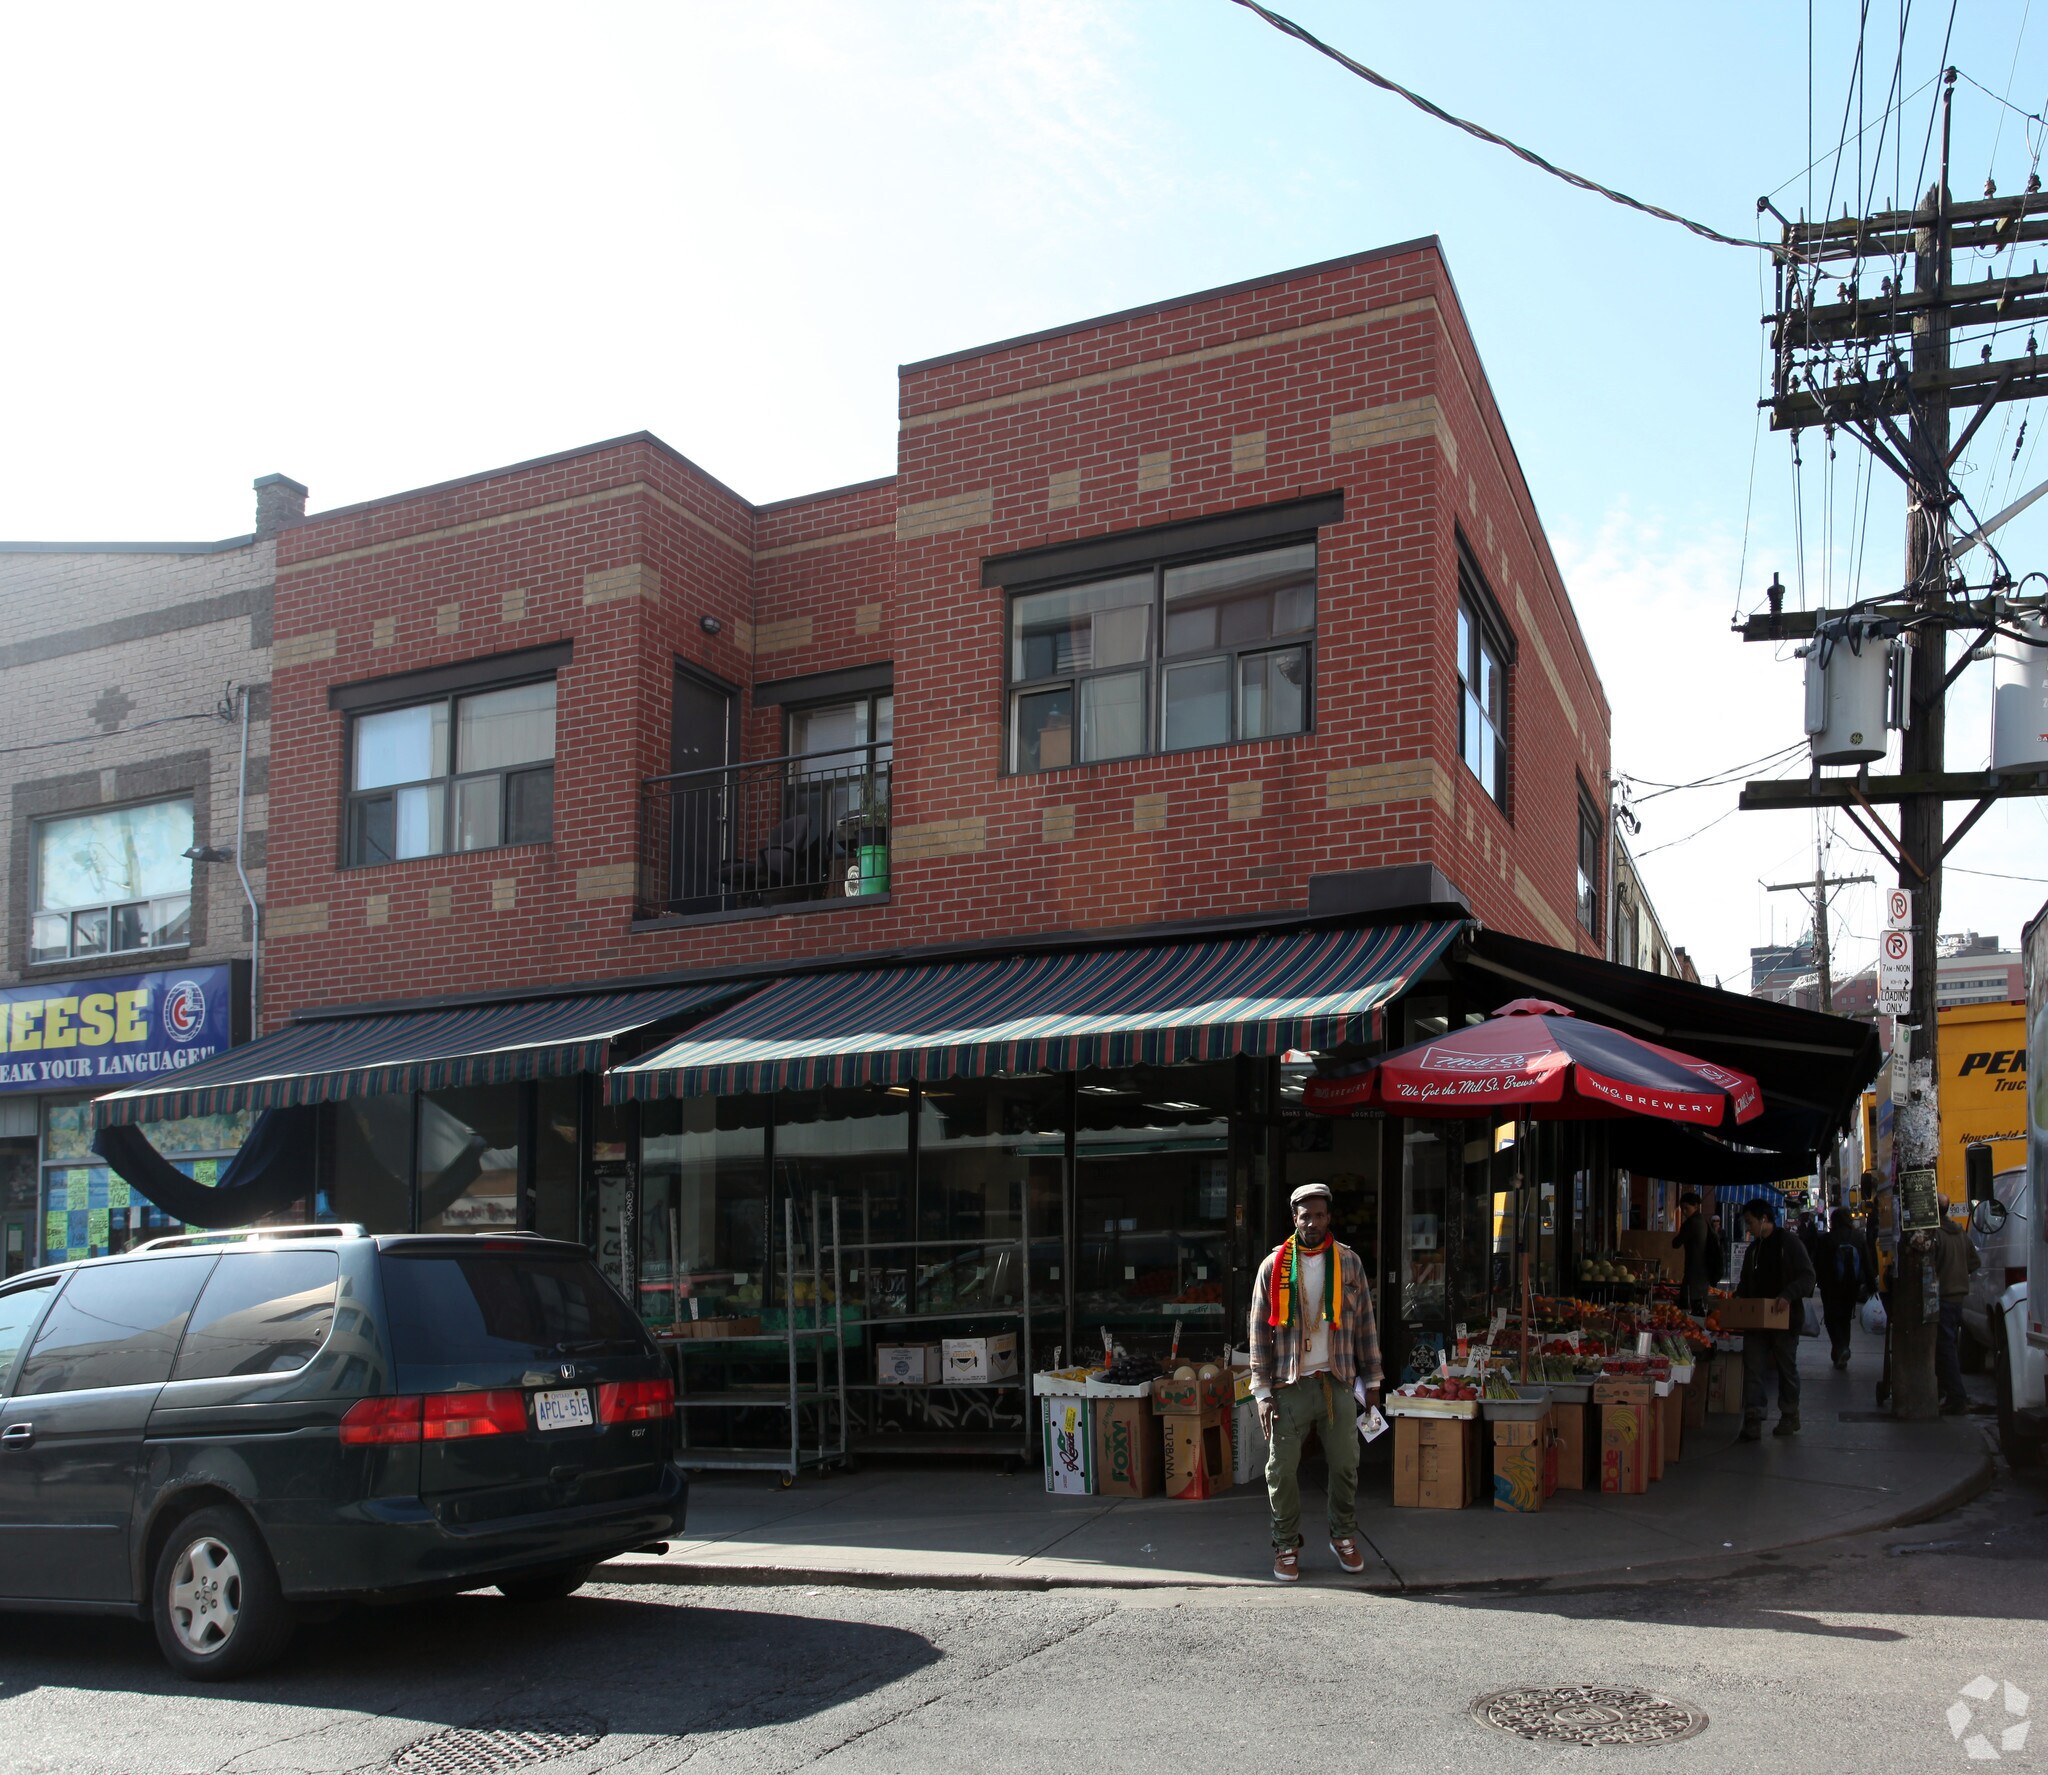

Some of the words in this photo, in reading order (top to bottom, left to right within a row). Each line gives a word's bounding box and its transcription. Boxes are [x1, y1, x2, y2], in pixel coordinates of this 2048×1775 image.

[1896, 965, 1910, 973] NOON
[1881, 990, 1909, 1002] LOADING
[1886, 1002, 1903, 1013] ONLY
[40, 1058, 94, 1080] YOUR
[1435, 1056, 1497, 1067] Mill
[1421, 1083, 1439, 1101] Got
[1441, 1082, 1456, 1096] the
[1458, 1079, 1484, 1094] Mill
[1484, 1077, 1500, 1092] St.
[1994, 1079, 2027, 1092] Truc
[1625, 1094, 1713, 1113] BREWERY
[1960, 1130, 2018, 1144] Household
[540, 1400, 565, 1421] APCL
[569, 1398, 590, 1417] 515
[1059, 1430, 1080, 1473] Read
[1164, 1423, 1175, 1480] TURBANA
[1231, 1417, 1239, 1472] VEGETABLES
[1603, 1450, 1619, 1492] Dole
